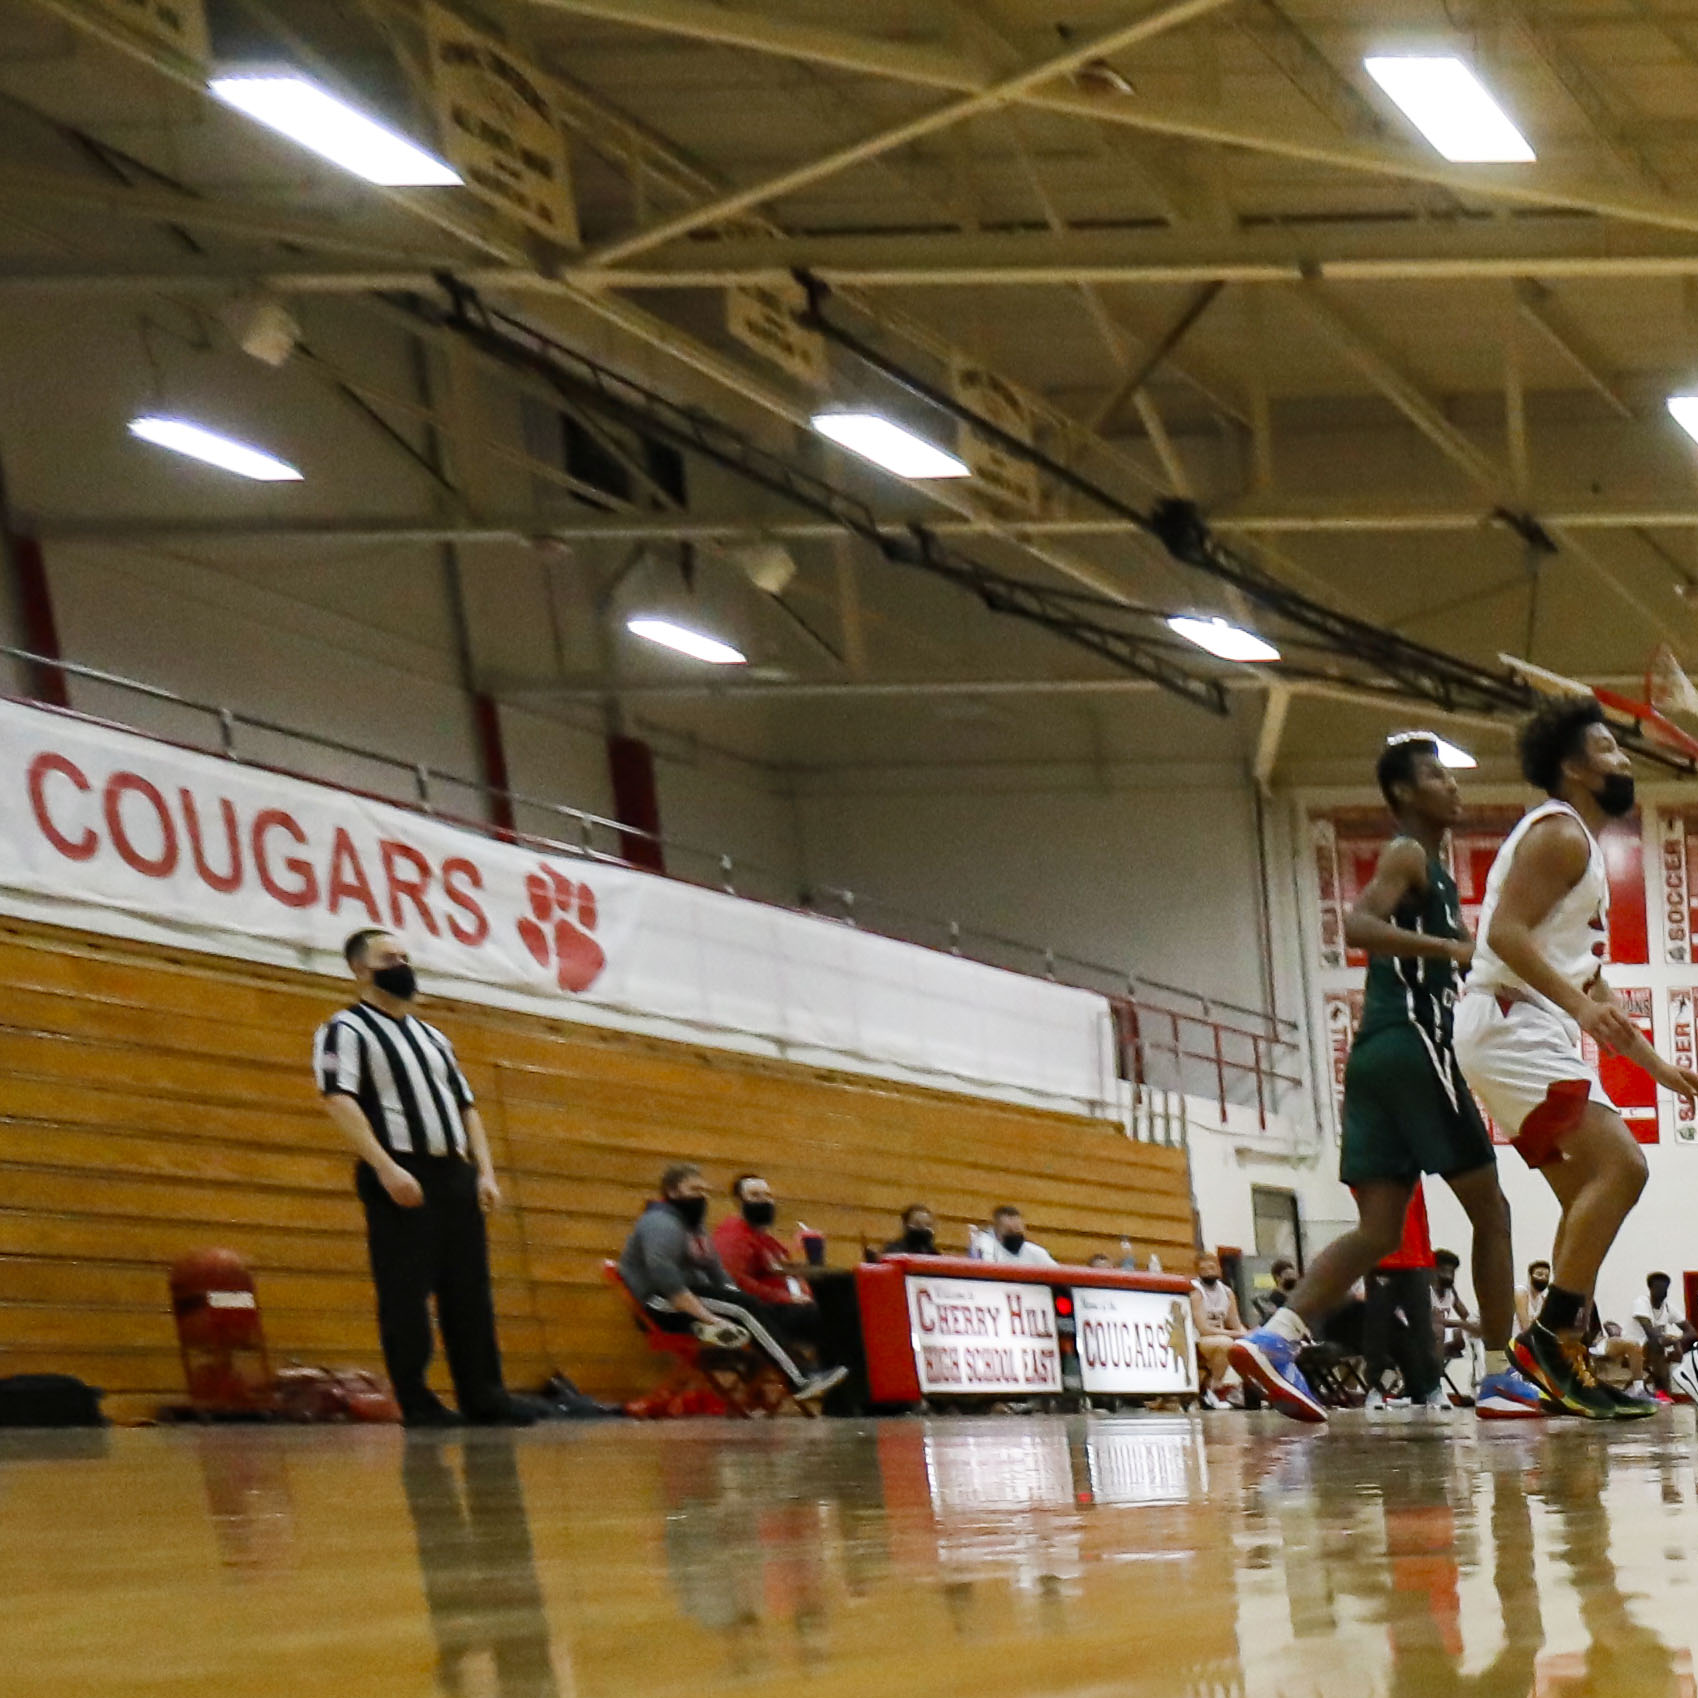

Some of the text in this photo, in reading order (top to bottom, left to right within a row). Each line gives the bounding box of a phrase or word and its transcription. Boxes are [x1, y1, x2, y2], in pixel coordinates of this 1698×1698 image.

[26, 750, 490, 946] COUGARS
[1664, 839, 1686, 942] SOCCER
[916, 1287, 1054, 1339] CHERRY HILL
[924, 1345, 1056, 1384] HIGH SCHOOL EAST
[1083, 1320, 1169, 1369] COUGARS
